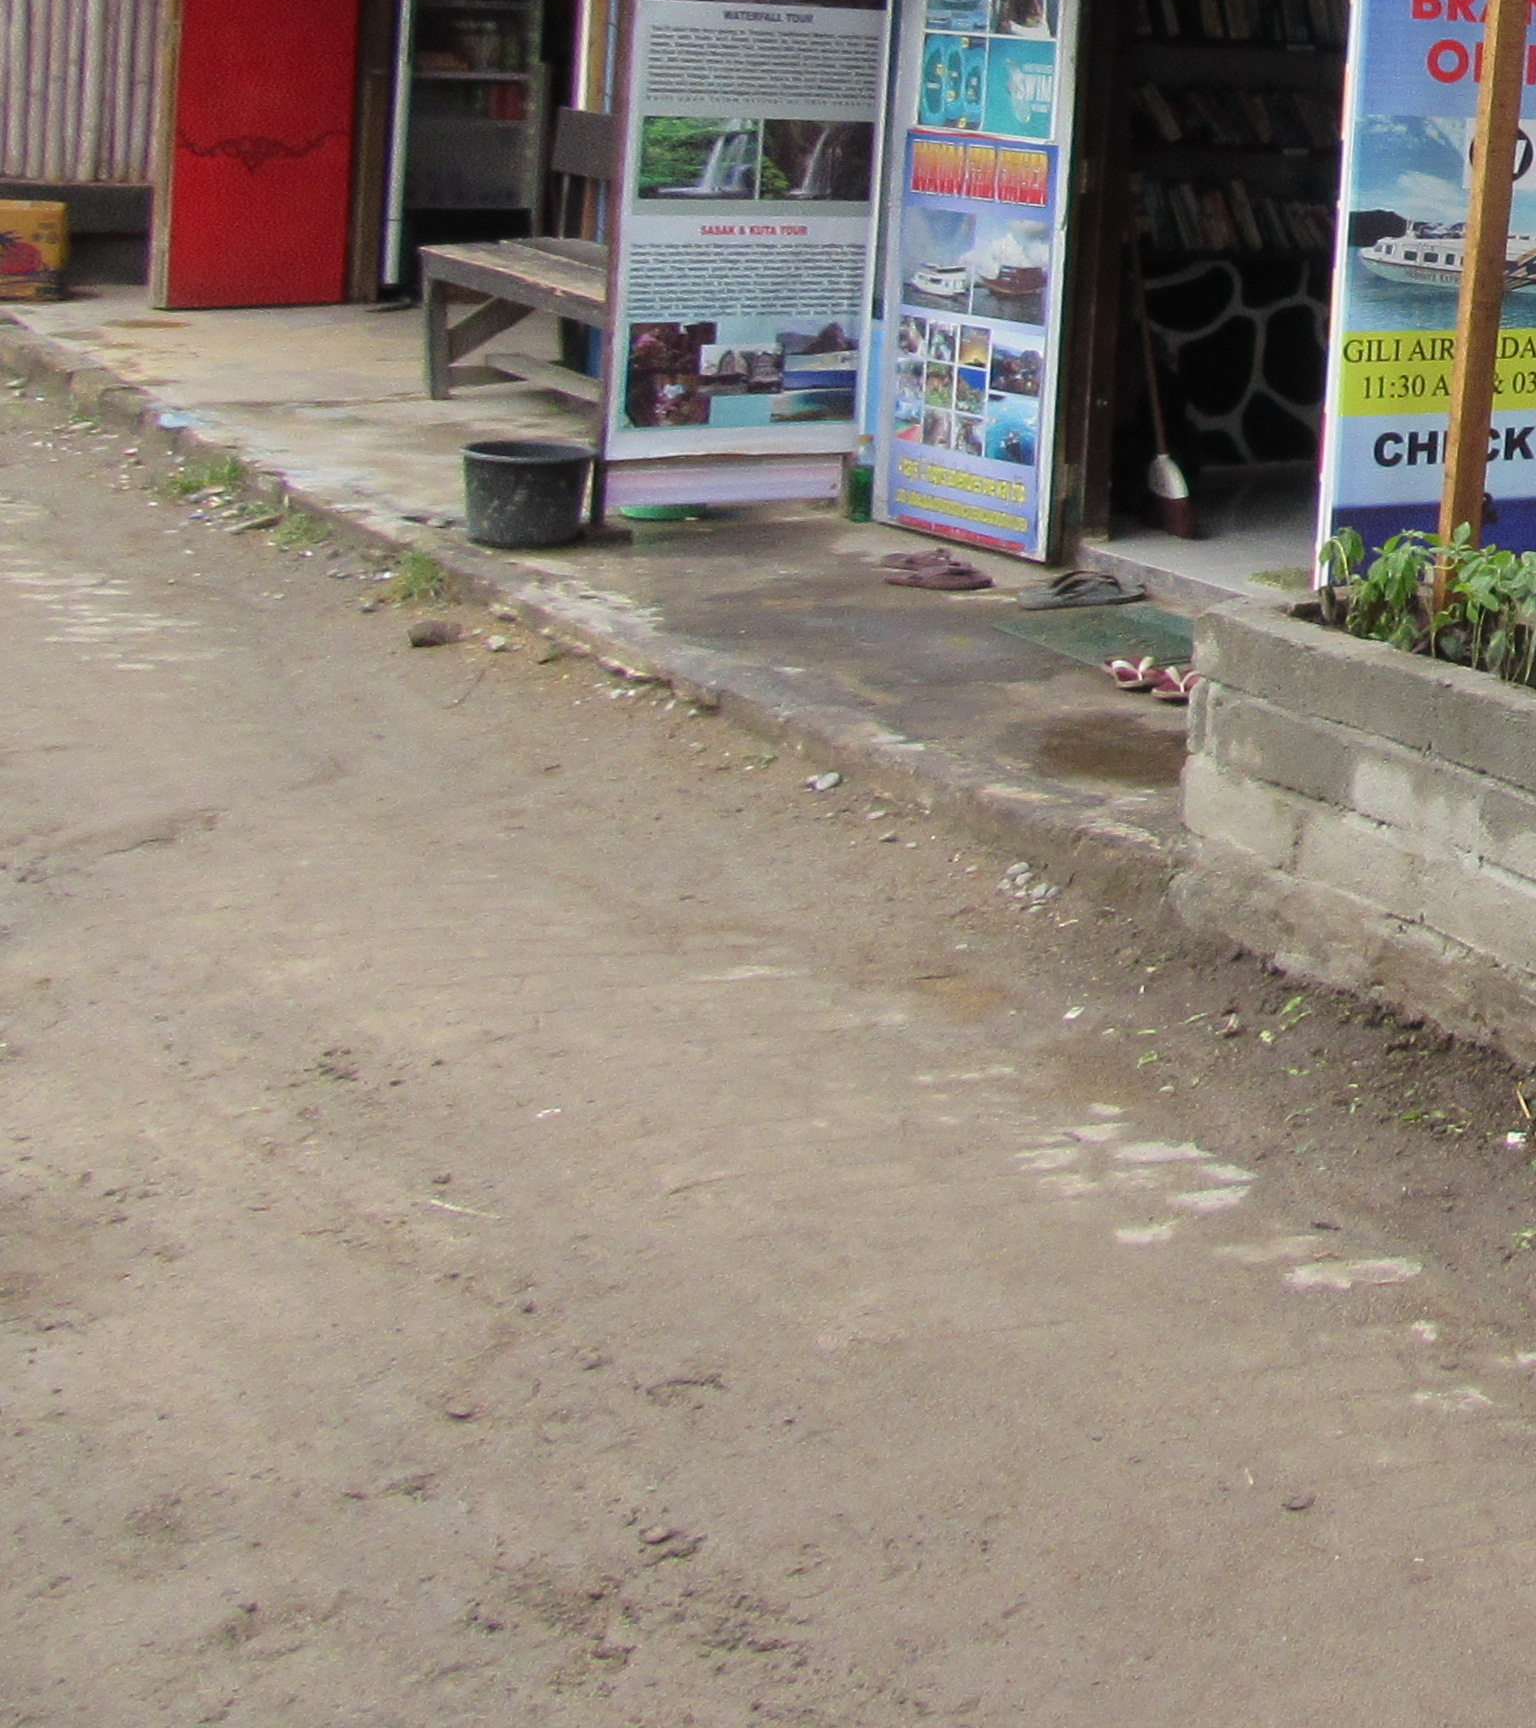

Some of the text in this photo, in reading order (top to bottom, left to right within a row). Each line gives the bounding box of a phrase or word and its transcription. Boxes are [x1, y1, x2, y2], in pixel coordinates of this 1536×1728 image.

[781, 225, 808, 235] TOUR
[1343, 338, 1401, 363] GILI
[1408, 337, 1455, 362] AIR
[1363, 374, 1425, 399] 11:30
[1373, 425, 1535, 467] CHCK
